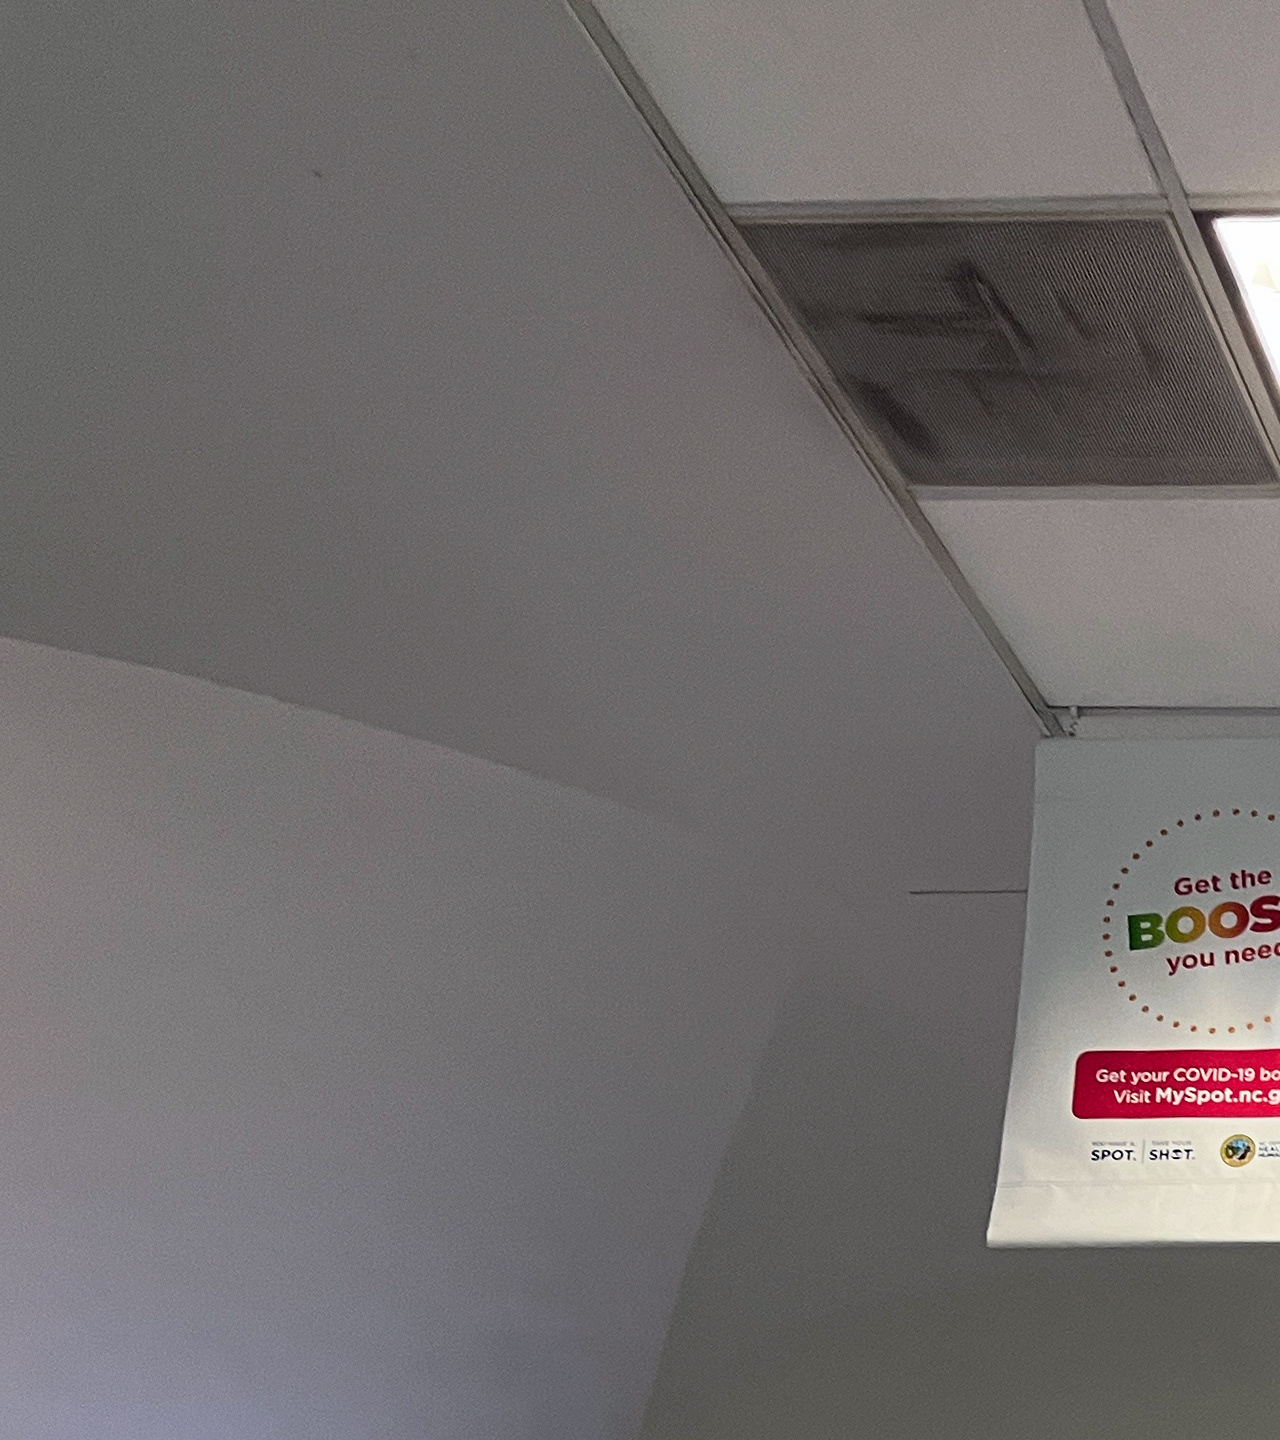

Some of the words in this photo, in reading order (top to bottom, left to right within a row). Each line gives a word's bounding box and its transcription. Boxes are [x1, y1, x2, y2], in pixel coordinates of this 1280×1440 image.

[1173, 876, 1223, 896] Get
[1229, 869, 1272, 890] the
[1166, 952, 1215, 976] you
[1095, 1068, 1127, 1083] Get
[1130, 1070, 1170, 1086] your
[1172, 1067, 1256, 1083] COVID-19
[1113, 1088, 1152, 1104] Visit
[1090, 1149, 1137, 1161] SPOT.
